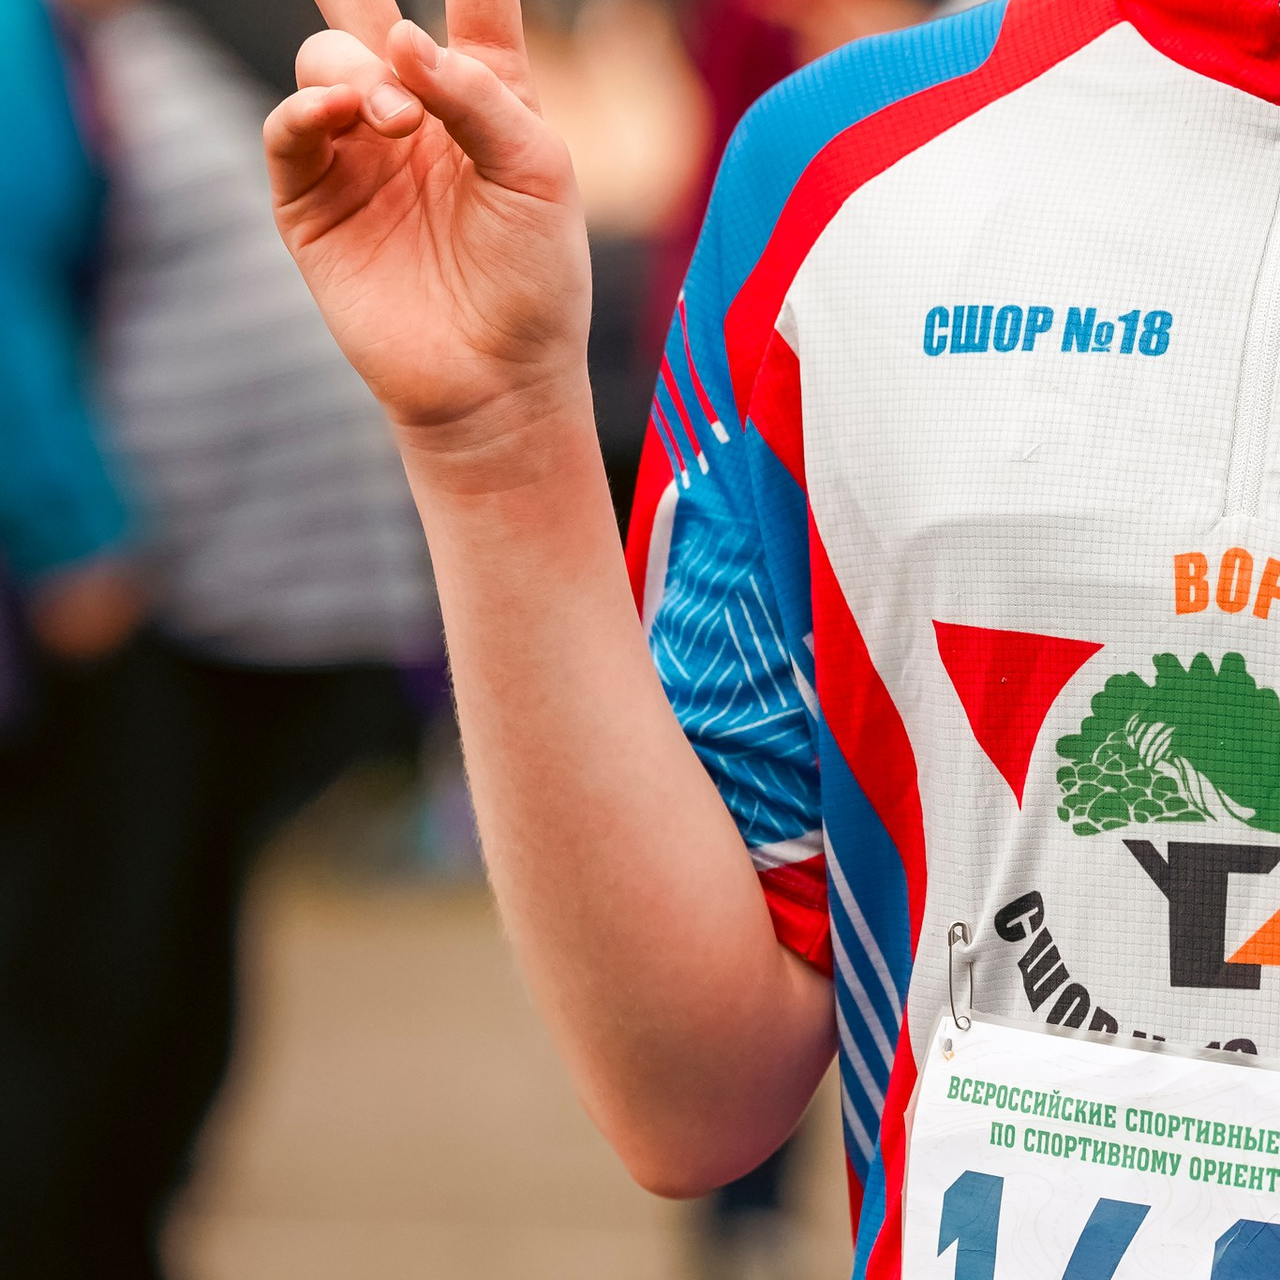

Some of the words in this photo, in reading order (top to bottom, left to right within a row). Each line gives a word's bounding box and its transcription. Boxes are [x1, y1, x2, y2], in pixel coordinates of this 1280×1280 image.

[923, 304, 1053, 356] СШОР
[1061, 307, 1173, 356] №18
[946, 1075, 1117, 1129] ВСЕРОССИЙСКИЕ
[1125, 1107, 1280, 1155] СПОРТИВНЫЕ
[989, 1121, 1016, 1149] ПО
[1023, 1127, 1182, 1177] СПОРТИВНОМУ
